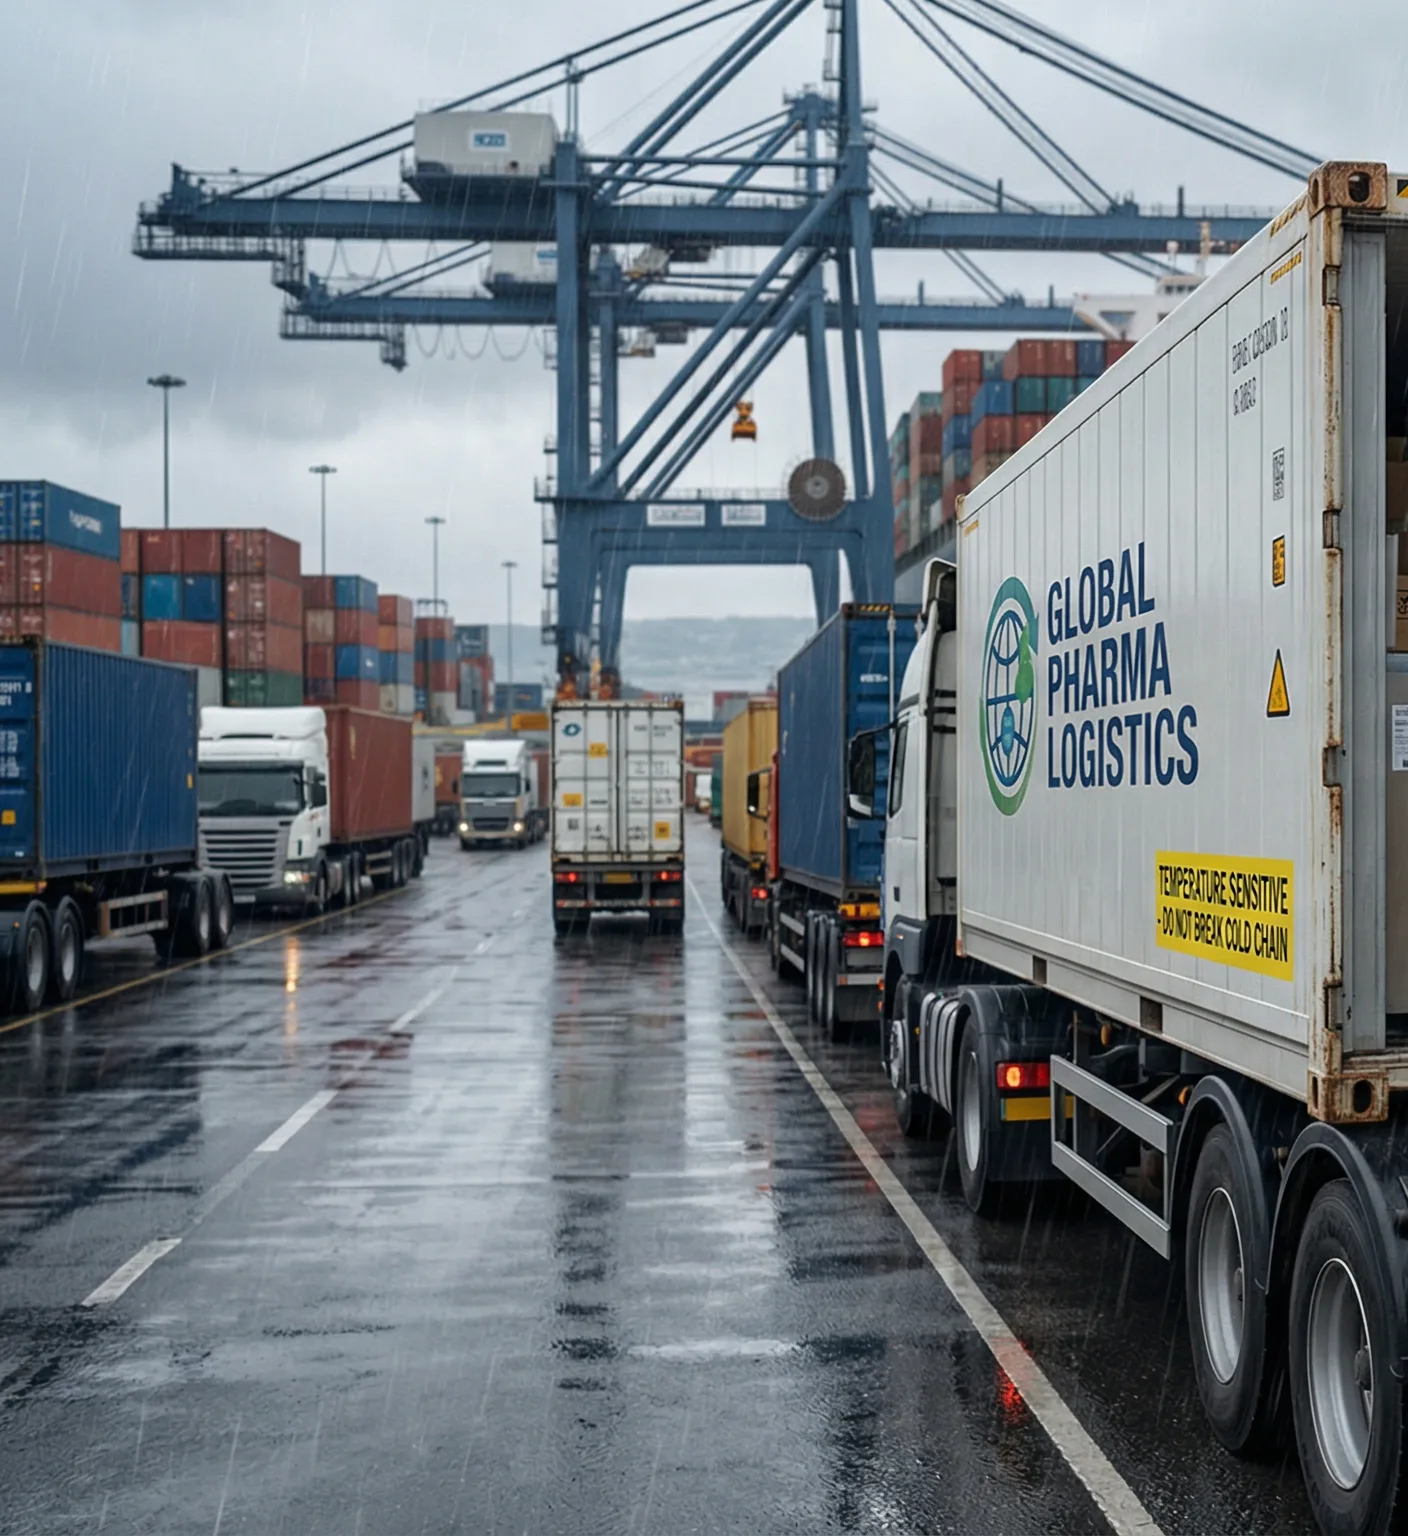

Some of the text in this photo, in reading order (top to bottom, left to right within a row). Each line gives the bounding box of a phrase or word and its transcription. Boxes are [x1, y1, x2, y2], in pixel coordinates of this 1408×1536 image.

[1048, 542, 1155, 646] GLOBAL
[1048, 621, 1171, 716] PHARMA
[1049, 704, 1198, 788] LOGISTICS
[1159, 865, 1288, 914] TEMPERATURE SENSITIVE
[1163, 906, 1174, 936] DO
[1176, 909, 1192, 939] NOT
[1194, 912, 1223, 948] BREAK
[1225, 917, 1251, 953] COLD
[1254, 922, 1287, 962] CHAIN
